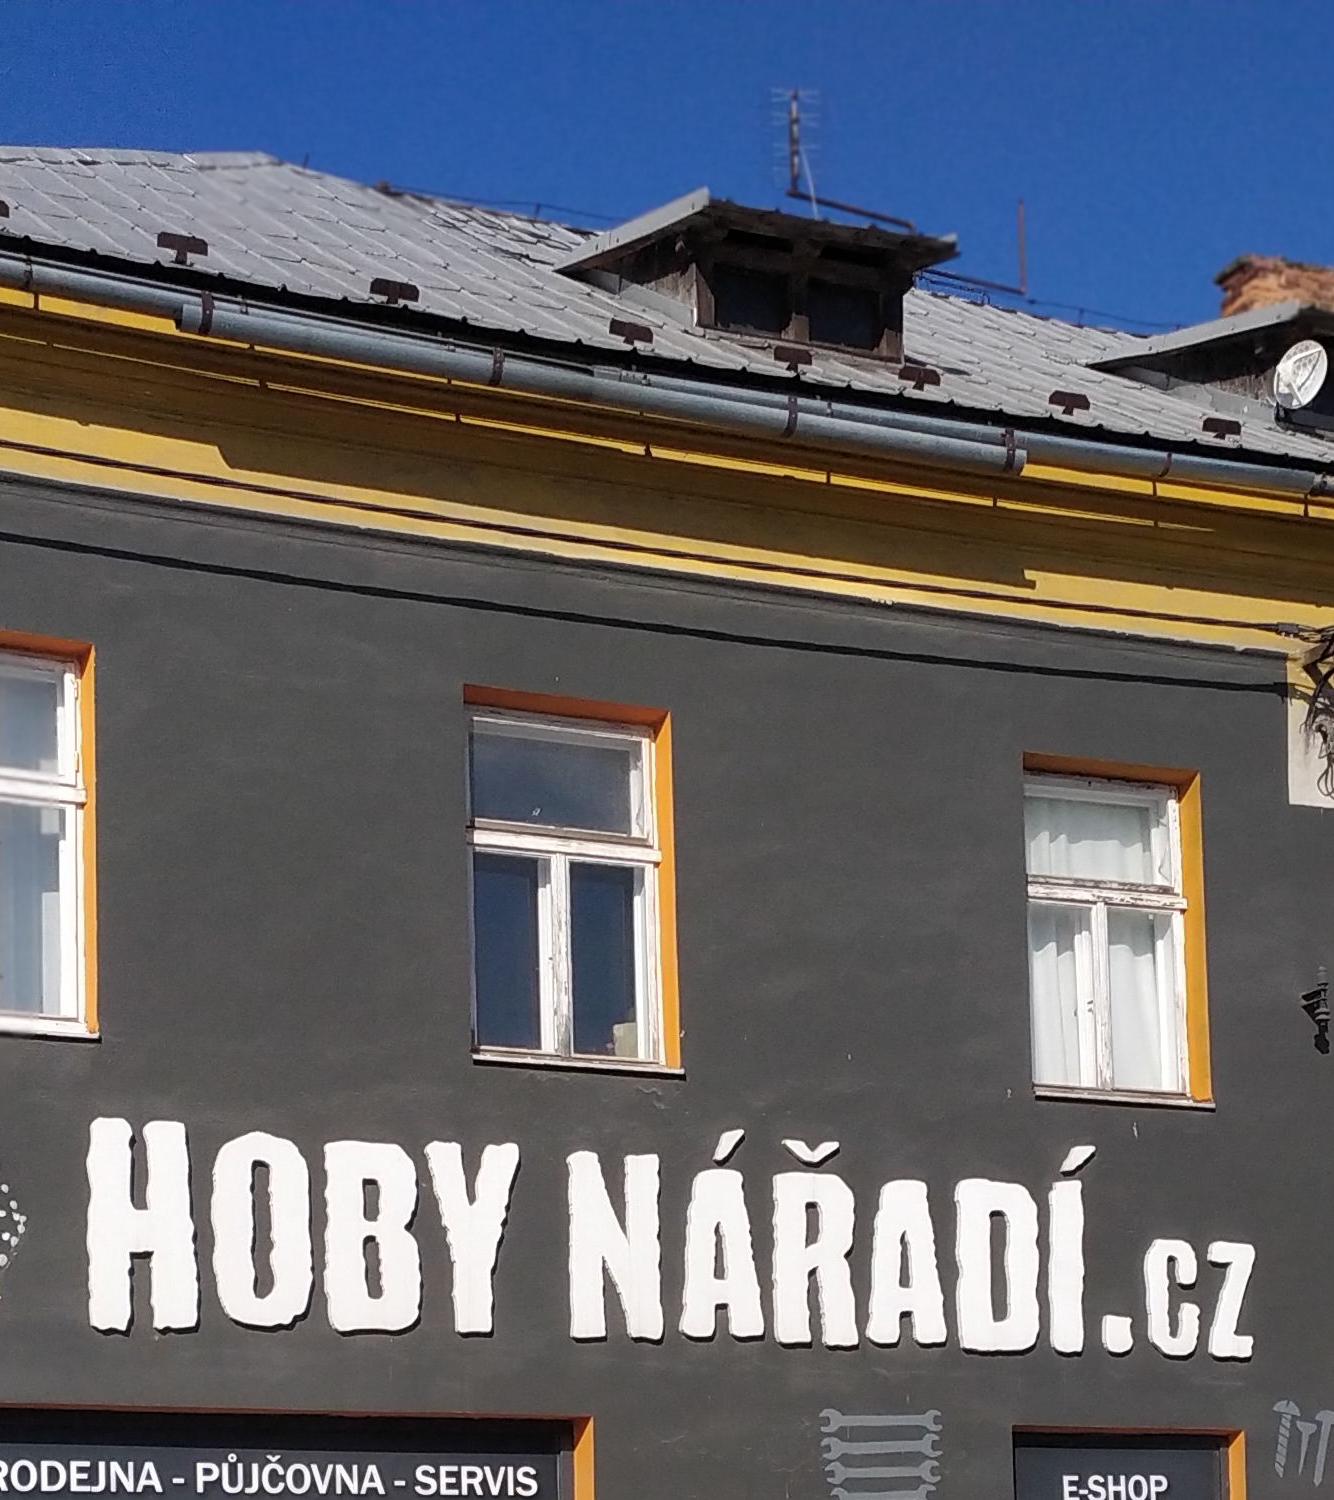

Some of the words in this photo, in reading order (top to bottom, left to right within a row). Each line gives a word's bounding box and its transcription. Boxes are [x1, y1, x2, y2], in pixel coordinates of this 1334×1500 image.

[85, 1116, 520, 1335] HOBY
[195, 1453, 386, 1495] PŮJČOVNA
[414, 1464, 539, 1497] SERVIS
